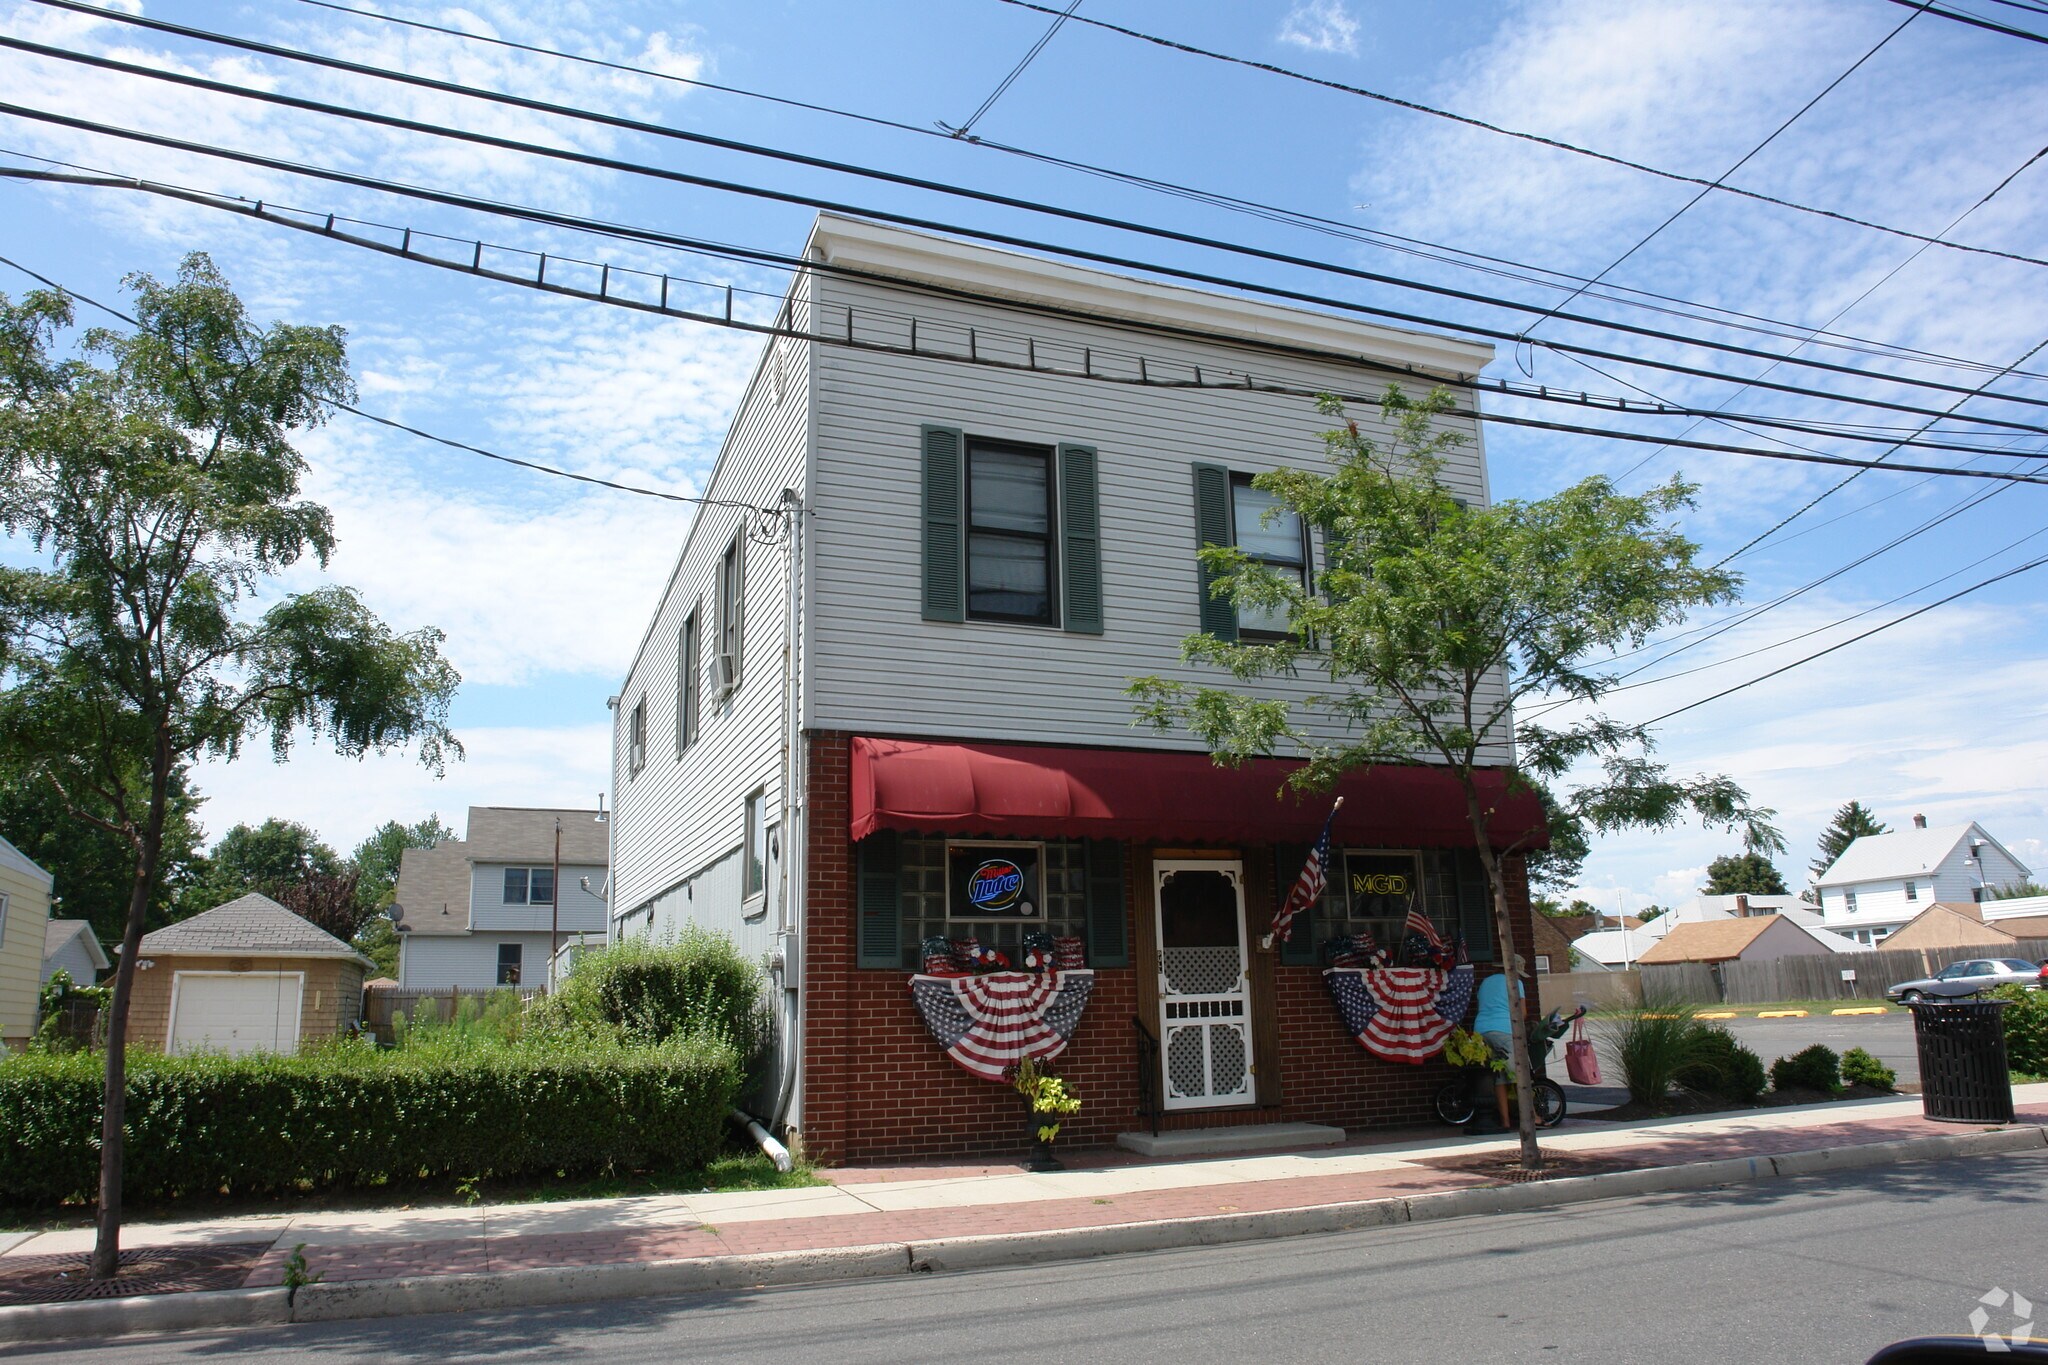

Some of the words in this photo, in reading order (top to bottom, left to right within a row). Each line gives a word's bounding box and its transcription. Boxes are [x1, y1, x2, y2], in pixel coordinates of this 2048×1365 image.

[980, 866, 1014, 880] Miller
[971, 874, 1019, 903] Lite
[1353, 874, 1407, 894] MGD
